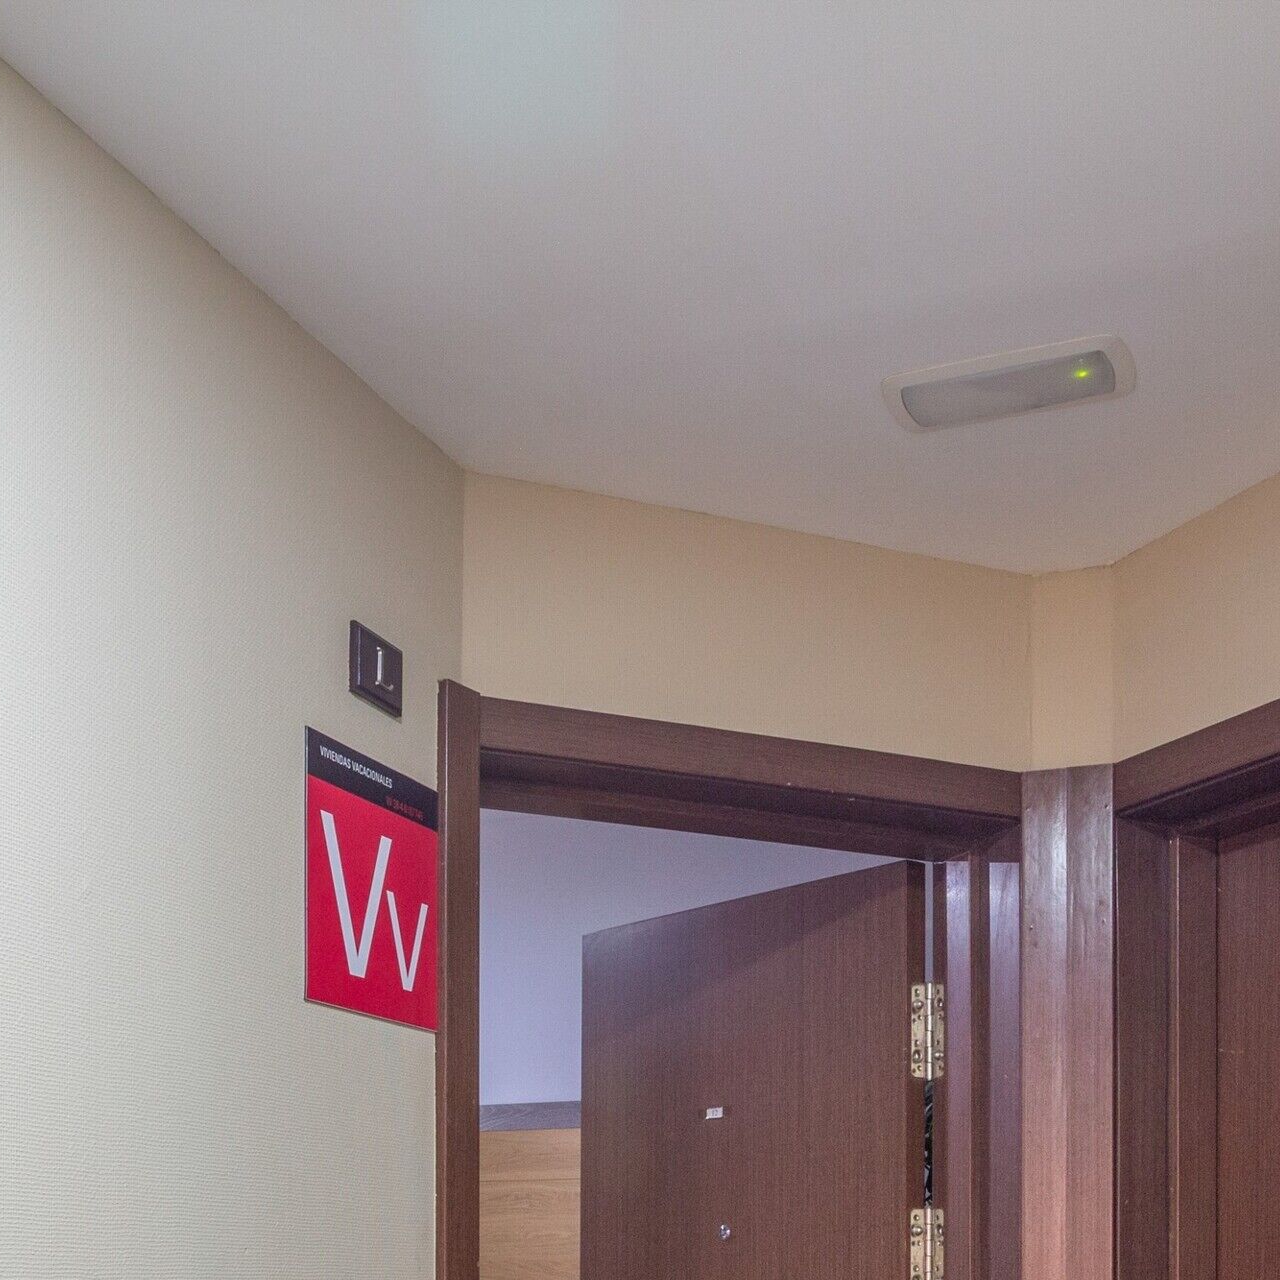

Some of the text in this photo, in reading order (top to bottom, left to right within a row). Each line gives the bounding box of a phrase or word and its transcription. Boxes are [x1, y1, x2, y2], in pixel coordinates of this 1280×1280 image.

[374, 646, 394, 691] L
[320, 745, 393, 789] VIVIENDAS VACACIONALES
